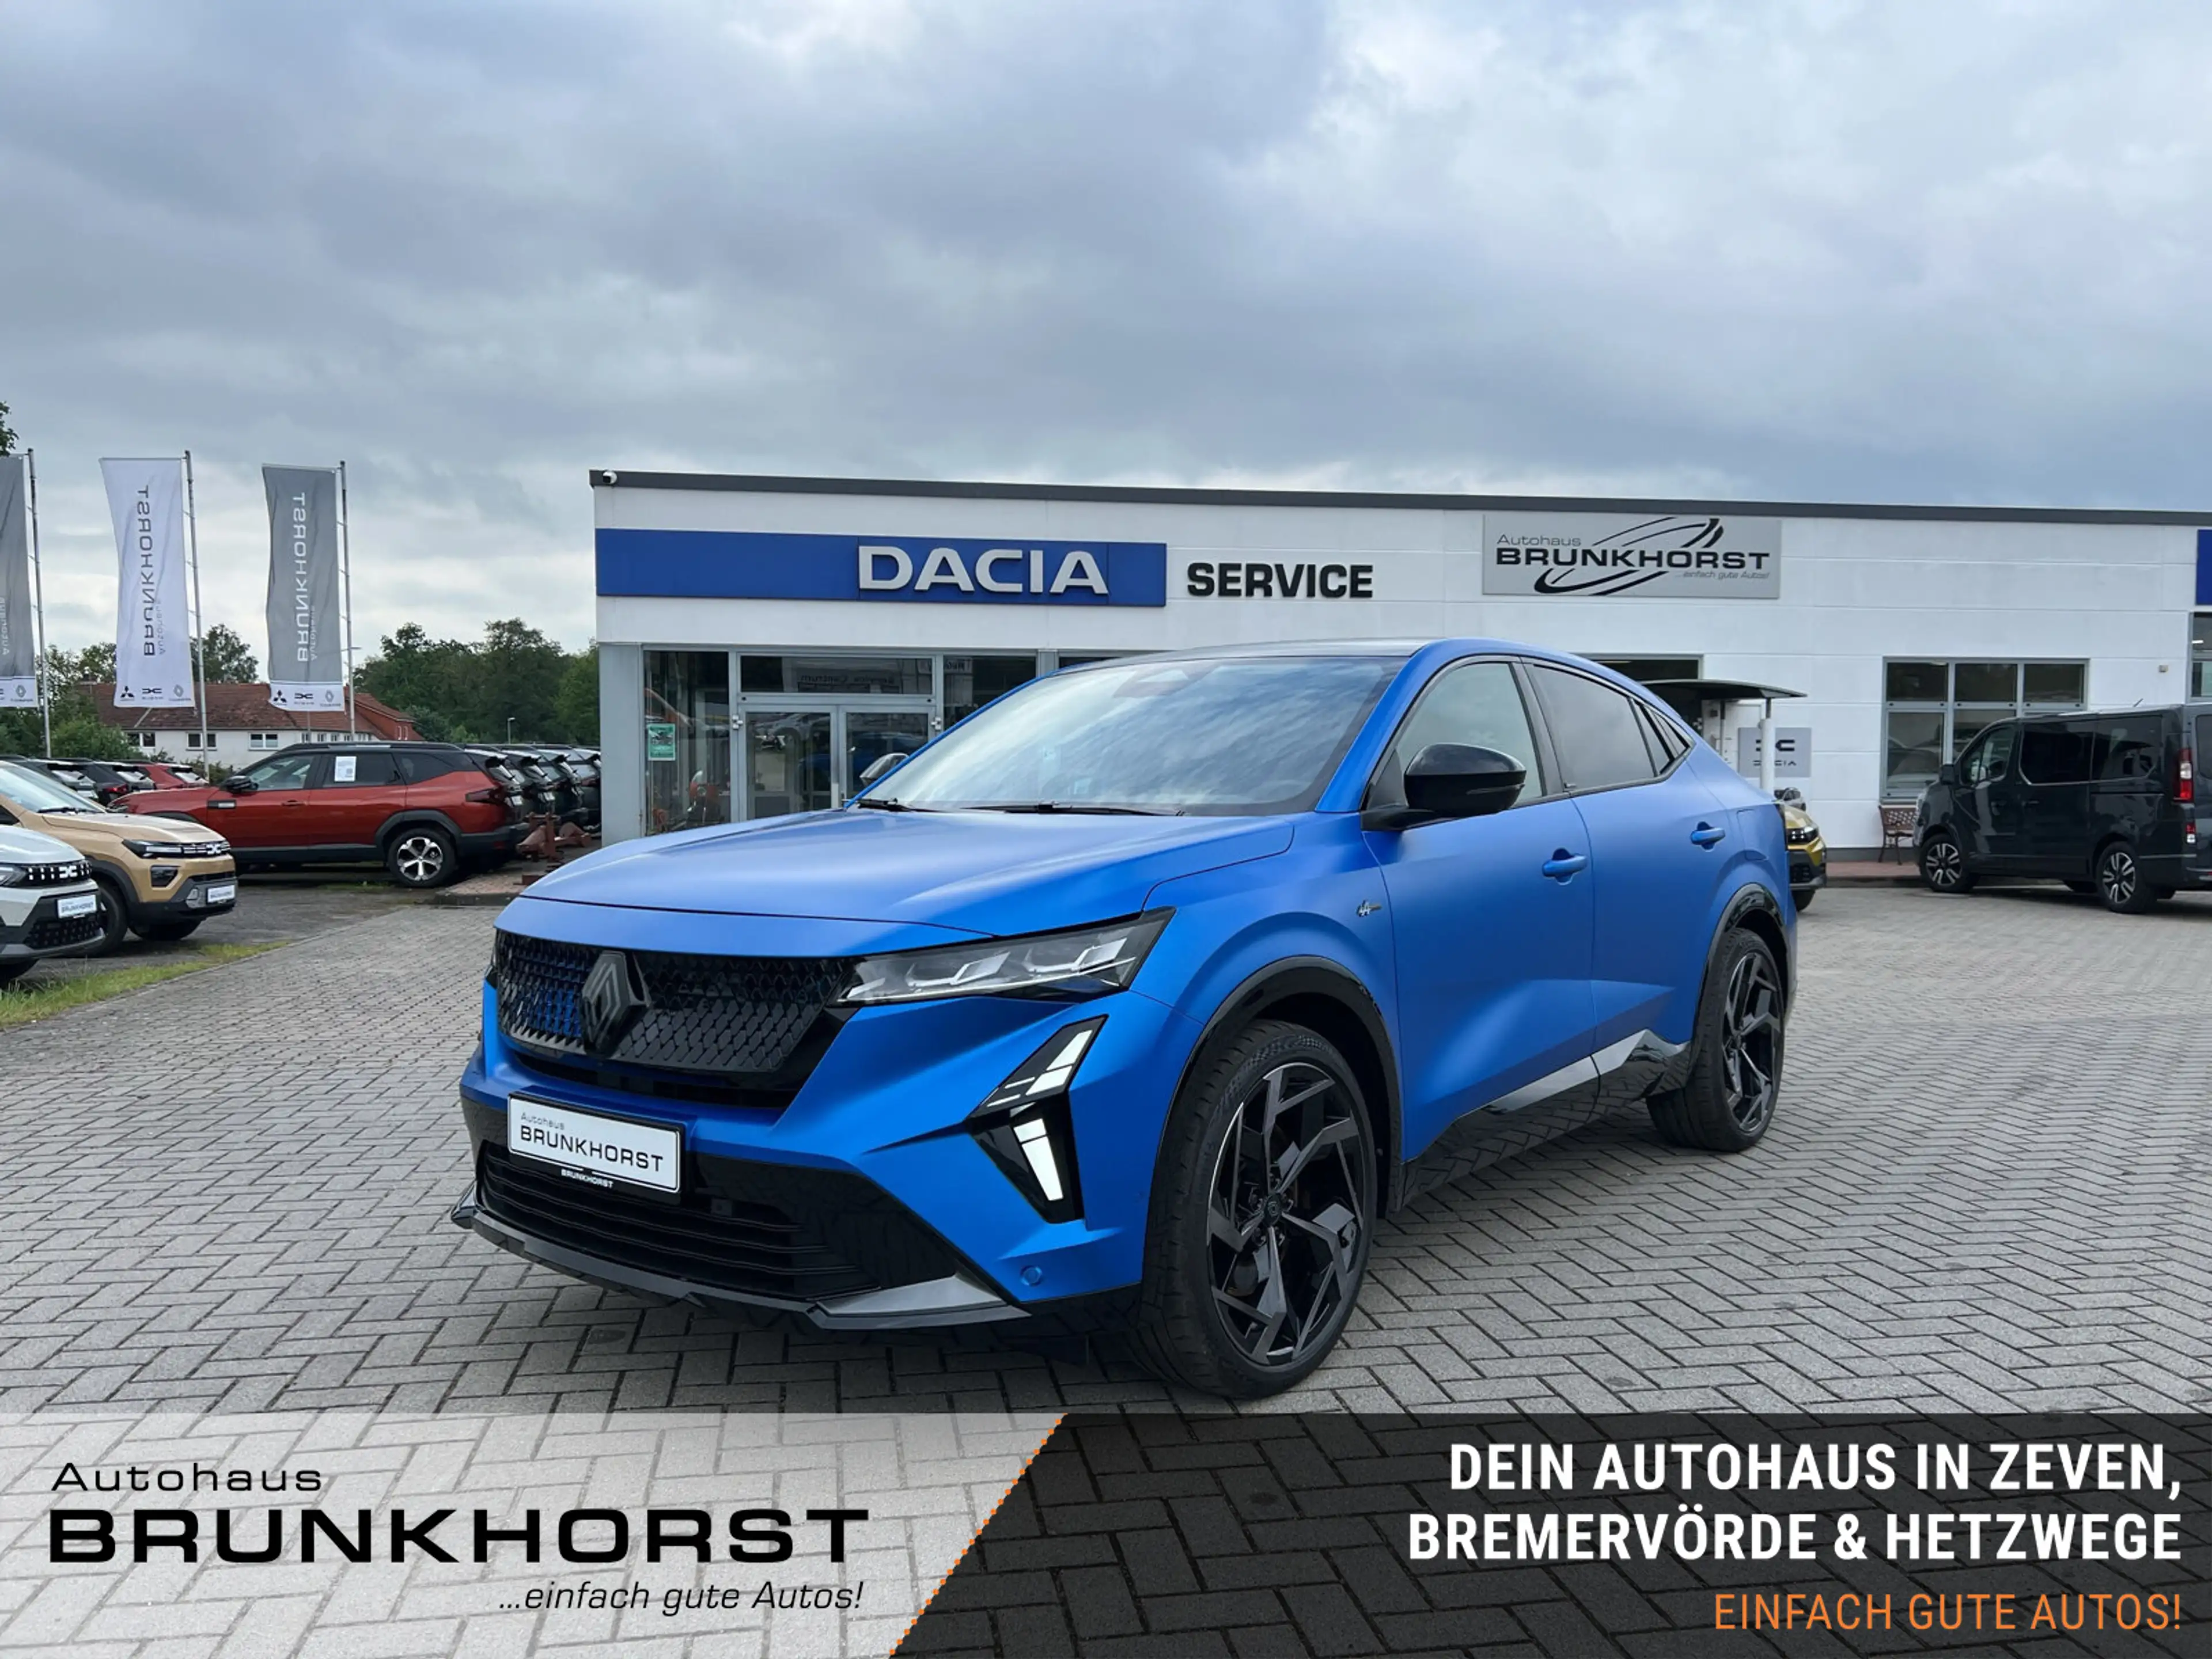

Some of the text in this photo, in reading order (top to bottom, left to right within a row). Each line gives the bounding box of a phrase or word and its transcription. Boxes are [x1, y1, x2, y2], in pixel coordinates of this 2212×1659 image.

[1497, 534, 1581, 547] Autohaus
[858, 545, 1109, 594] DACIA
[1496, 548, 1770, 570] BRUNKHORST
[1187, 562, 1373, 599] SERVICE
[521, 1112, 565, 1130] Autohaus
[520, 1125, 664, 1172] BRUNKHORST
[560, 1168, 614, 1188] BRUNKHORST
